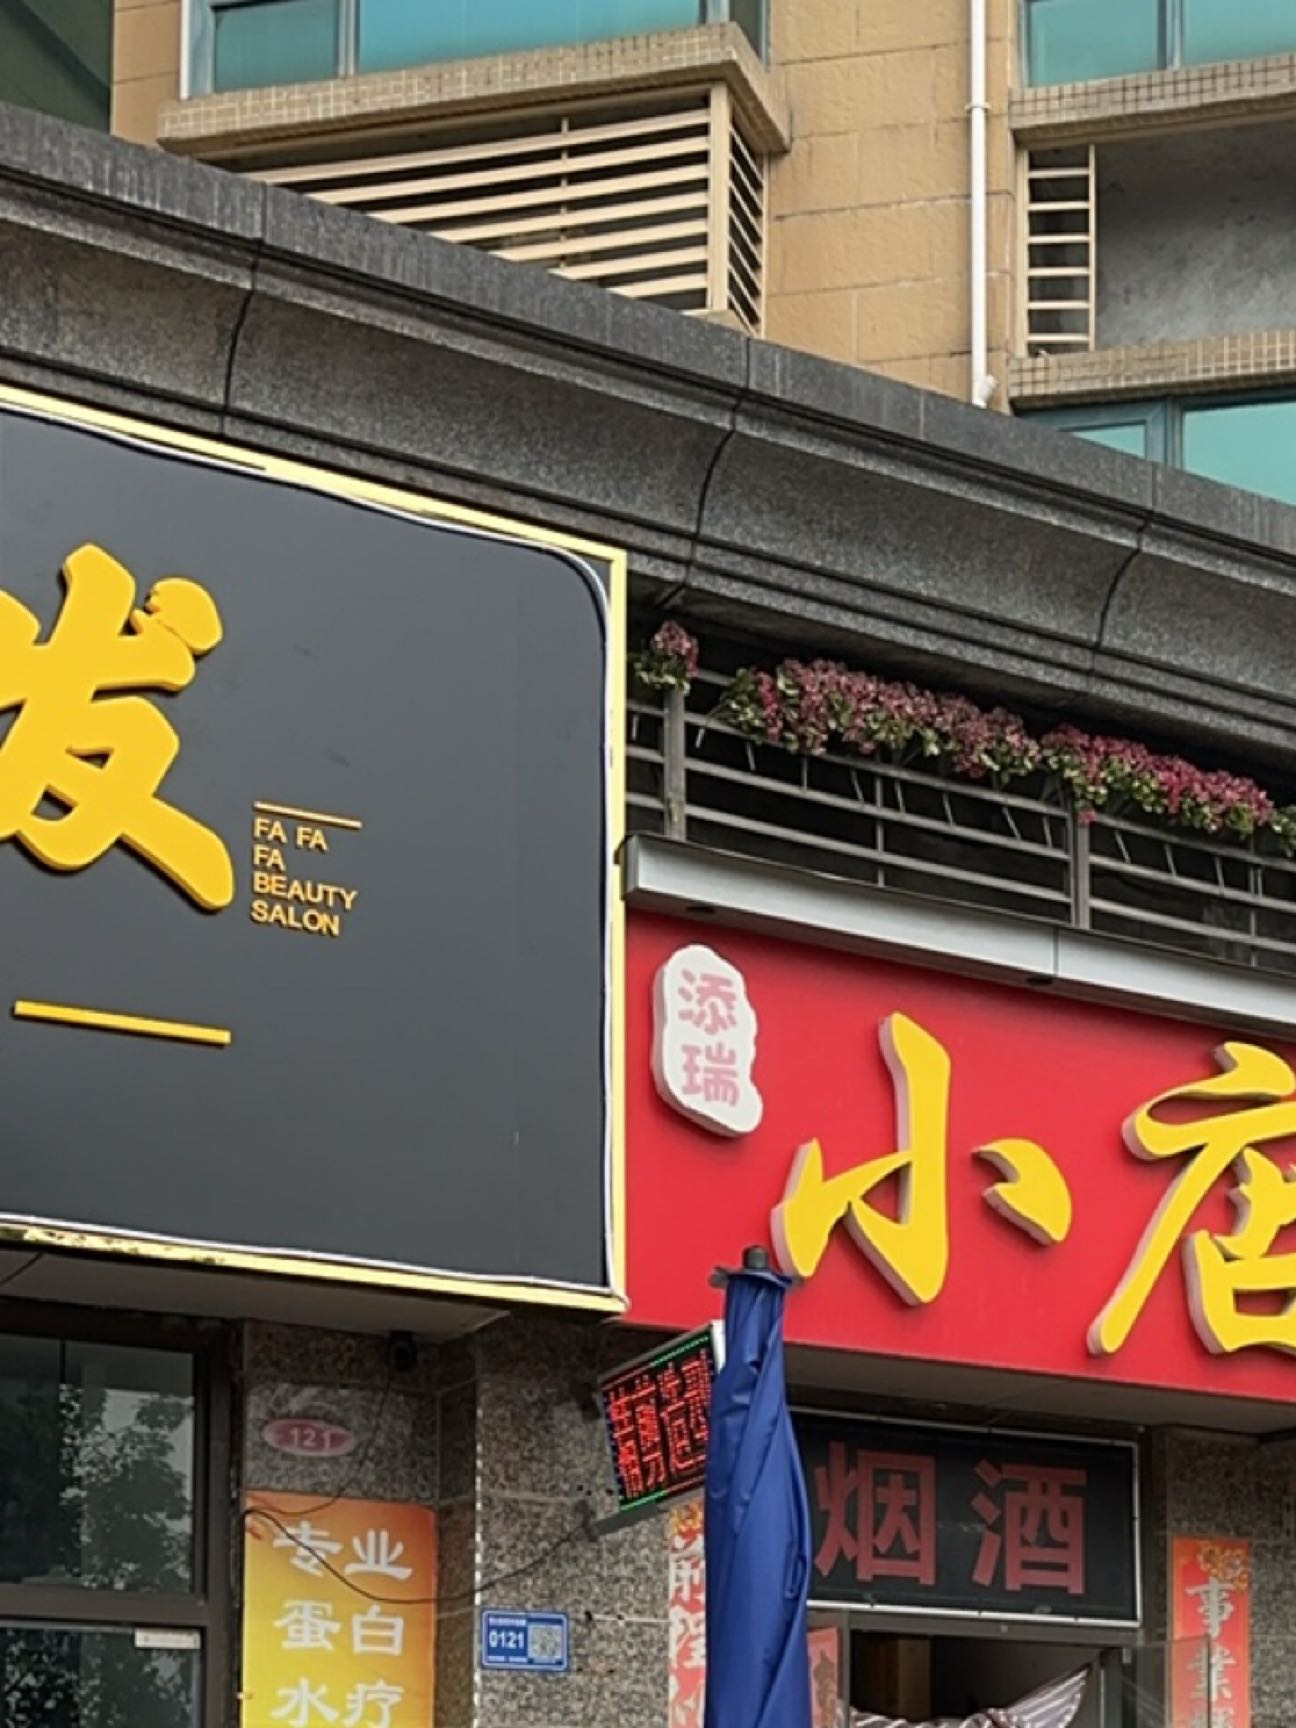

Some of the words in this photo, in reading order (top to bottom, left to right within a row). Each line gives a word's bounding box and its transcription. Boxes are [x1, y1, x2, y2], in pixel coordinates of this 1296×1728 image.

[0, 542, 234, 910] 发
[253, 817, 287, 843] FA
[297, 826, 328, 851] FA
[253, 844, 286, 871] FA
[253, 871, 357, 910] BEAUTY
[251, 899, 340, 936] SALON
[678, 971, 741, 1107] 添瑞
[290, 1428, 332, 1449] 121
[814, 1441, 1087, 1595] 烟酒
[273, 1519, 413, 1583] 专业
[273, 1602, 404, 1657] 蛋白
[488, 1630, 525, 1649] 0121
